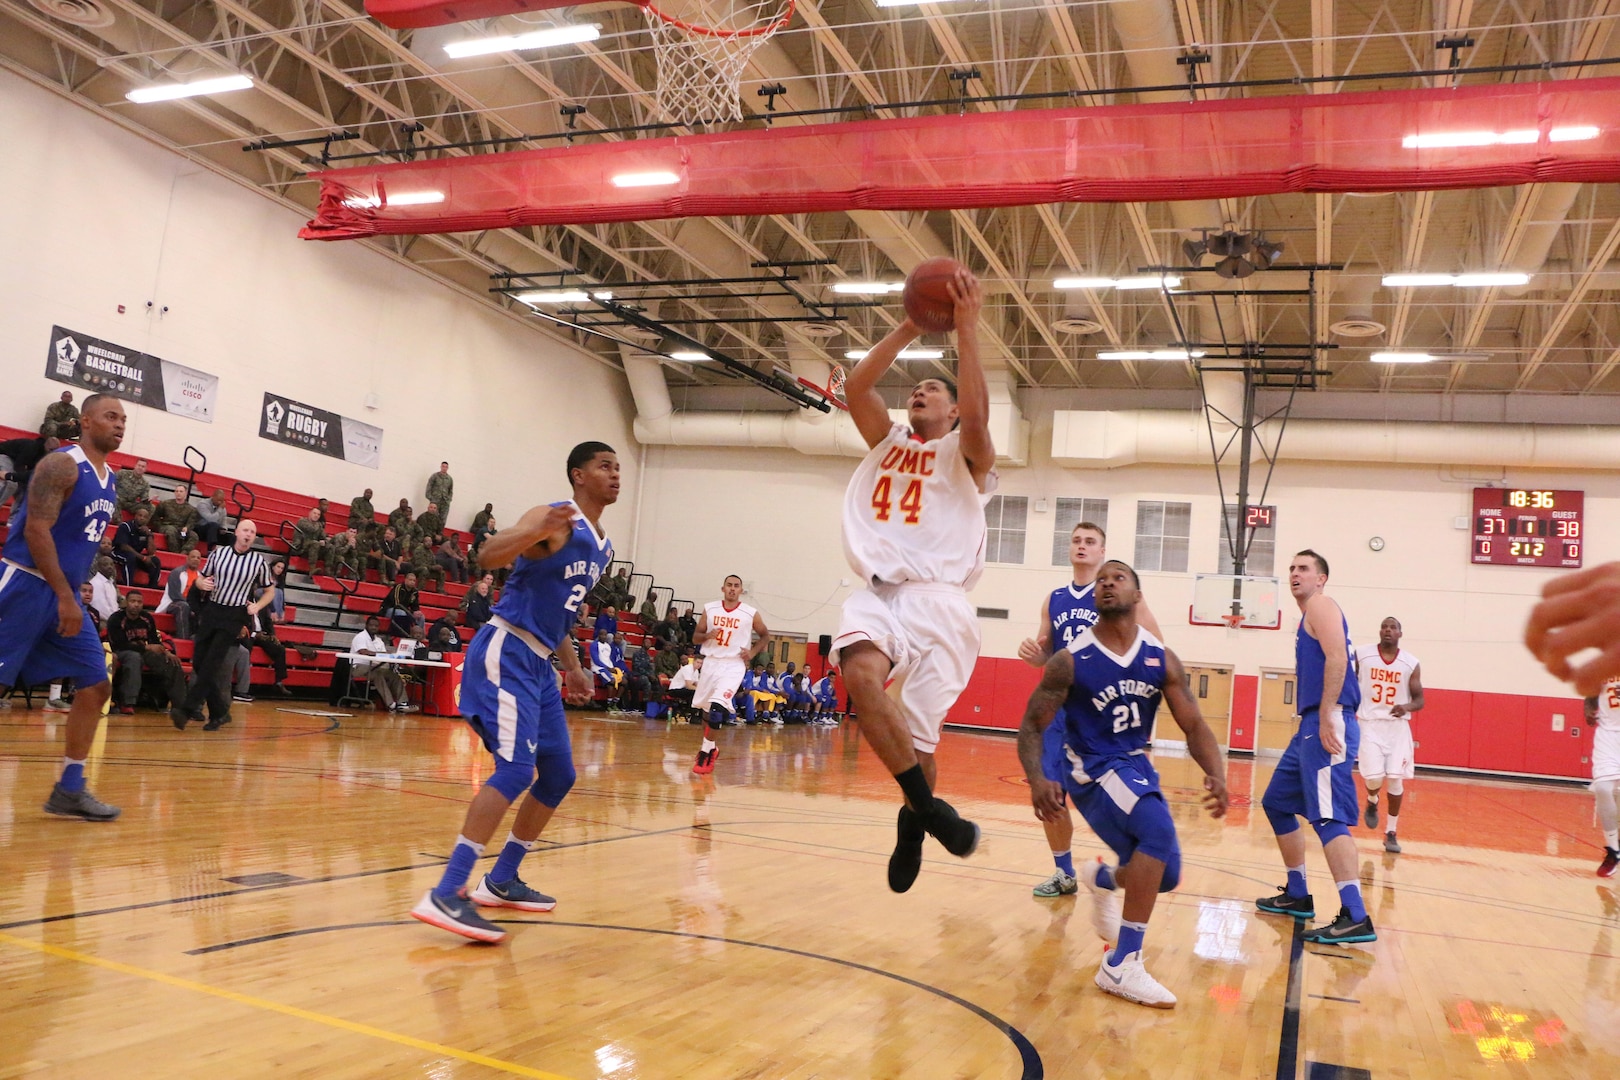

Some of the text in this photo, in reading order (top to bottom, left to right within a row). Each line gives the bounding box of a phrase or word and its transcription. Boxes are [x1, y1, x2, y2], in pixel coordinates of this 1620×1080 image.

[87, 345, 126, 363] WHEELCHAIR
[85, 354, 143, 382] BASKETBALL
[182, 389, 202, 400] CISCO
[286, 411, 328, 439] RUGBY
[84, 499, 99, 518] AIR
[871, 474, 923, 525] 44
[1509, 490, 1554, 509] 18:36
[1247, 507, 1270, 525] 24
[1479, 508, 1502, 517] HOME
[1551, 510, 1578, 519] GUEST
[84, 518, 107, 543] 43
[1484, 518, 1506, 534] 37
[1527, 521, 1533, 534] 1
[1557, 520, 1580, 537] 38
[1481, 541, 1491, 554] 0
[1568, 544, 1579, 558] 0
[564, 560, 587, 580] AIR
[713, 615, 741, 629] USMC
[1053, 611, 1069, 631] AIR
[715, 629, 733, 647] 41
[1370, 667, 1402, 684] USMC
[1091, 678, 1160, 712] AIR FORC
[1371, 683, 1397, 706] 32
[1112, 701, 1142, 734] 21
